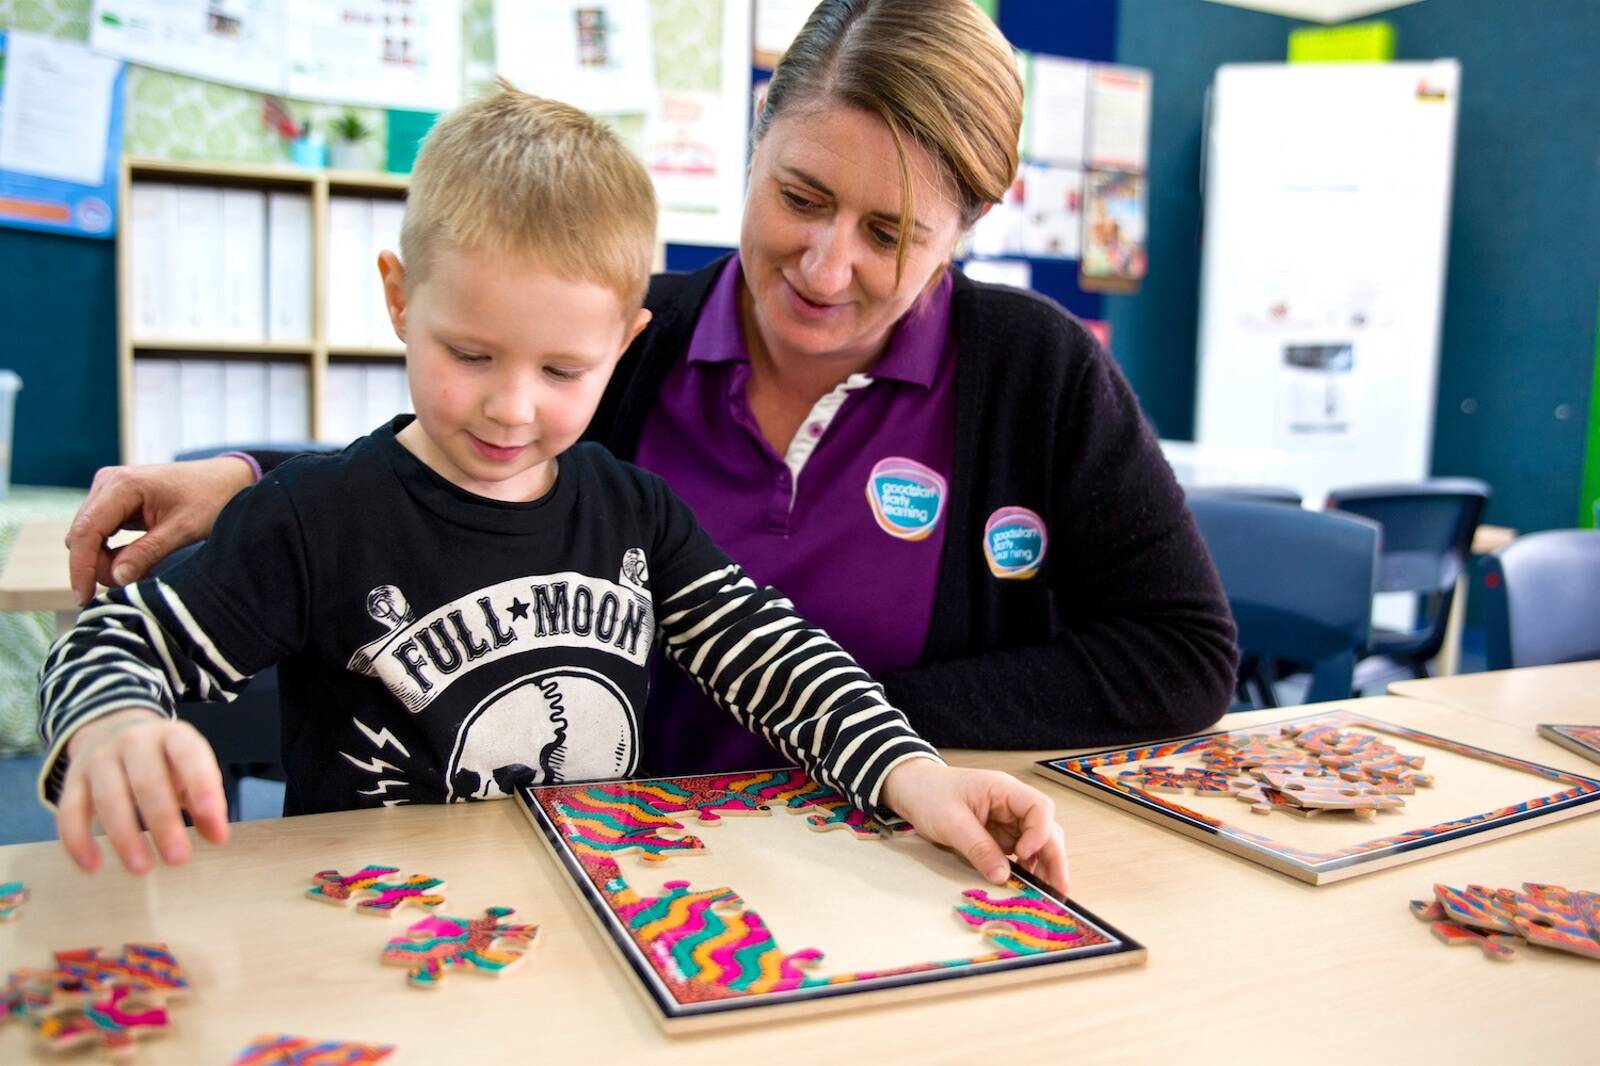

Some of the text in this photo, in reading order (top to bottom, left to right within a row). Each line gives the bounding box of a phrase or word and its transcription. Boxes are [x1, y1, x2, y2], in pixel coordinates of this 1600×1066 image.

[882, 483, 936, 497] goodstart
[882, 494, 911, 508] early
[883, 504, 928, 522] learning
[994, 527, 1037, 542] goodstart
[392, 581, 646, 693] FULL MOON
